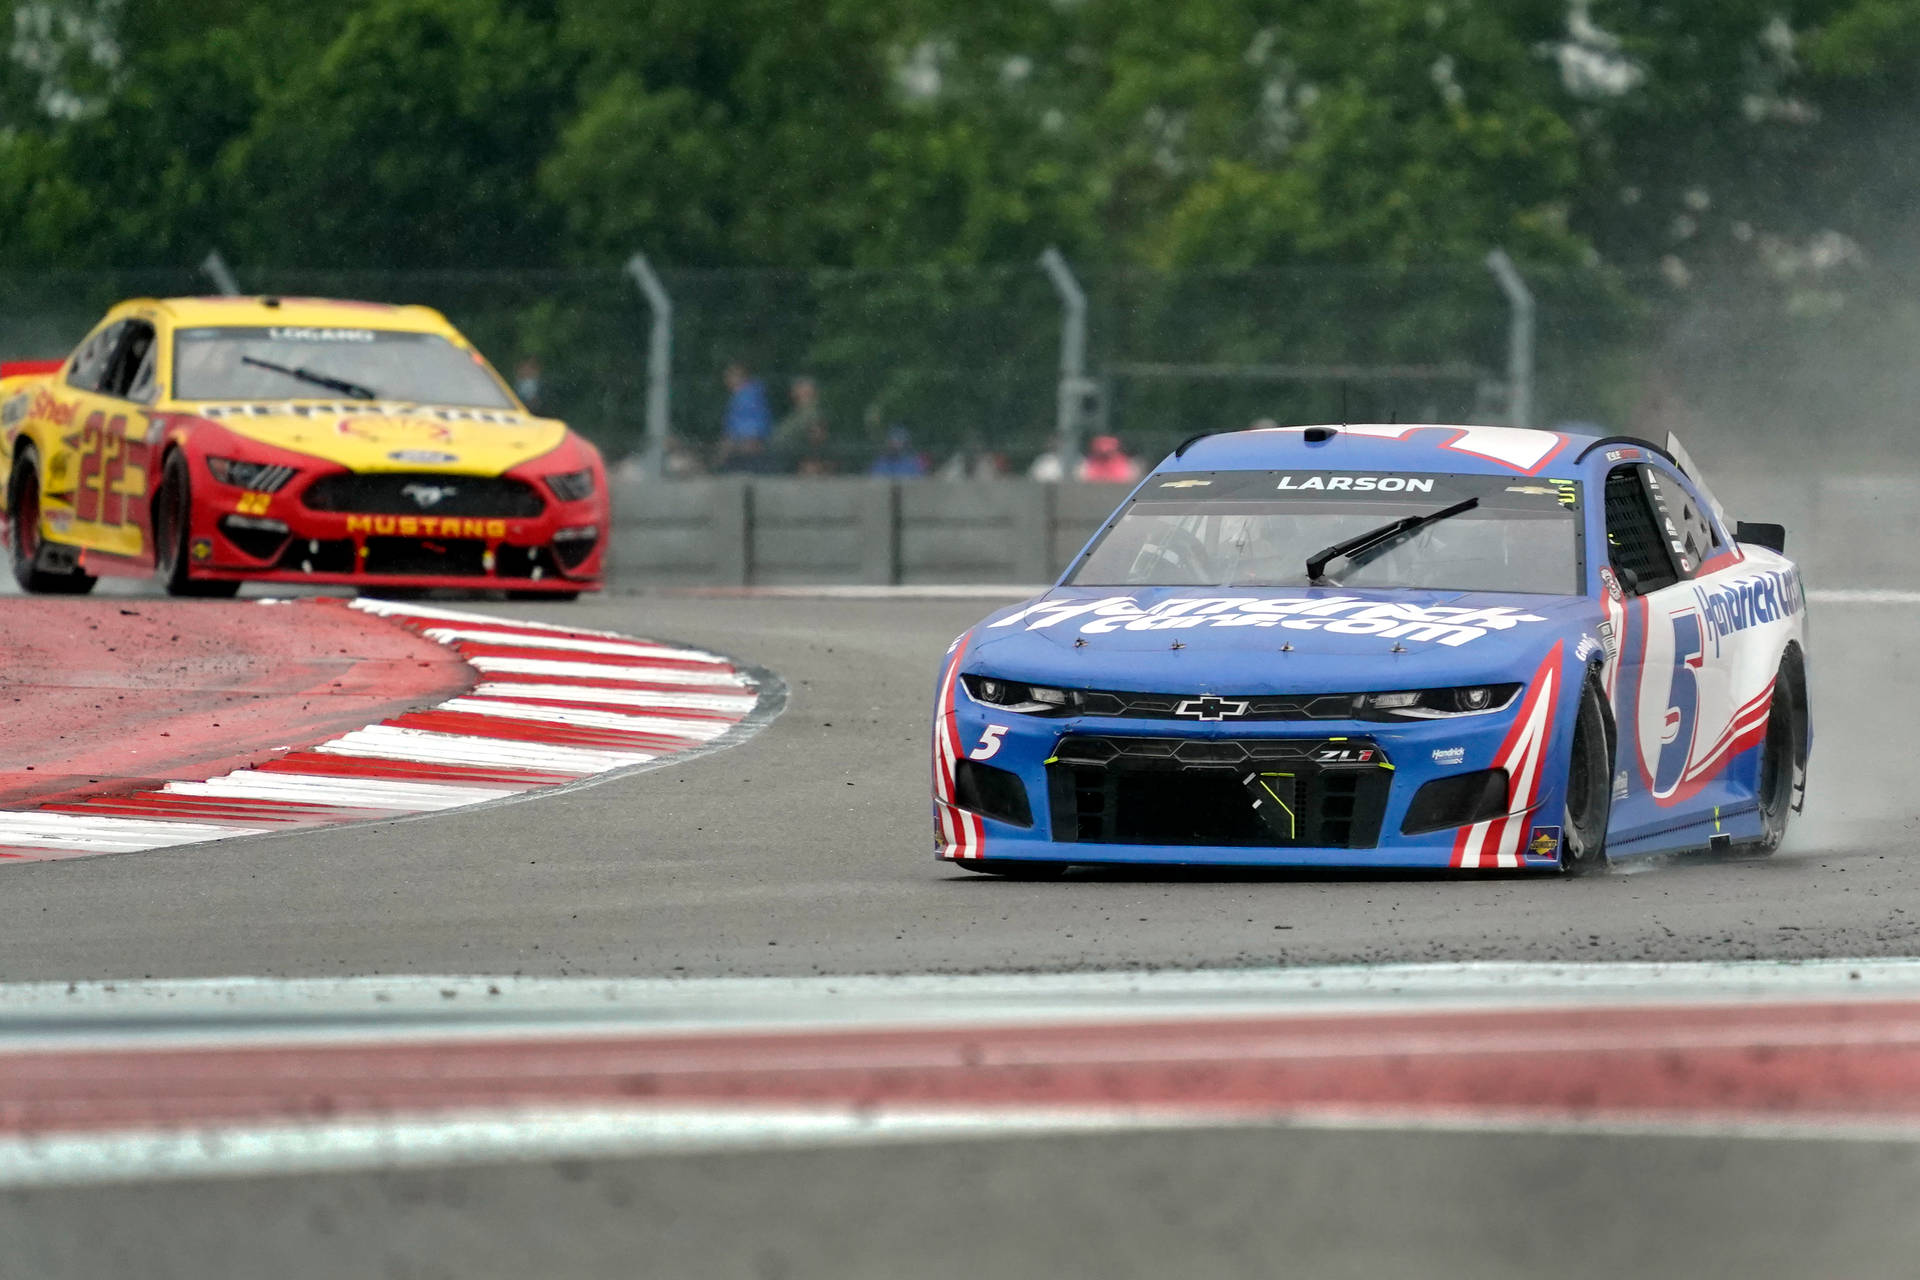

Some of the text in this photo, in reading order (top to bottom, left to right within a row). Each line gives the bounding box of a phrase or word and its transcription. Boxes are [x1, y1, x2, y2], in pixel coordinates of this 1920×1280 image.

[75, 410, 127, 528] 22
[1276, 476, 1434, 493] LARSON
[236, 491, 272, 515] 22
[347, 516, 507, 537] MUSTANG
[1652, 606, 1704, 800] 5
[968, 724, 1009, 761] 5
[1315, 749, 1375, 763] ZL1
[1432, 747, 1465, 761] Hendrick
